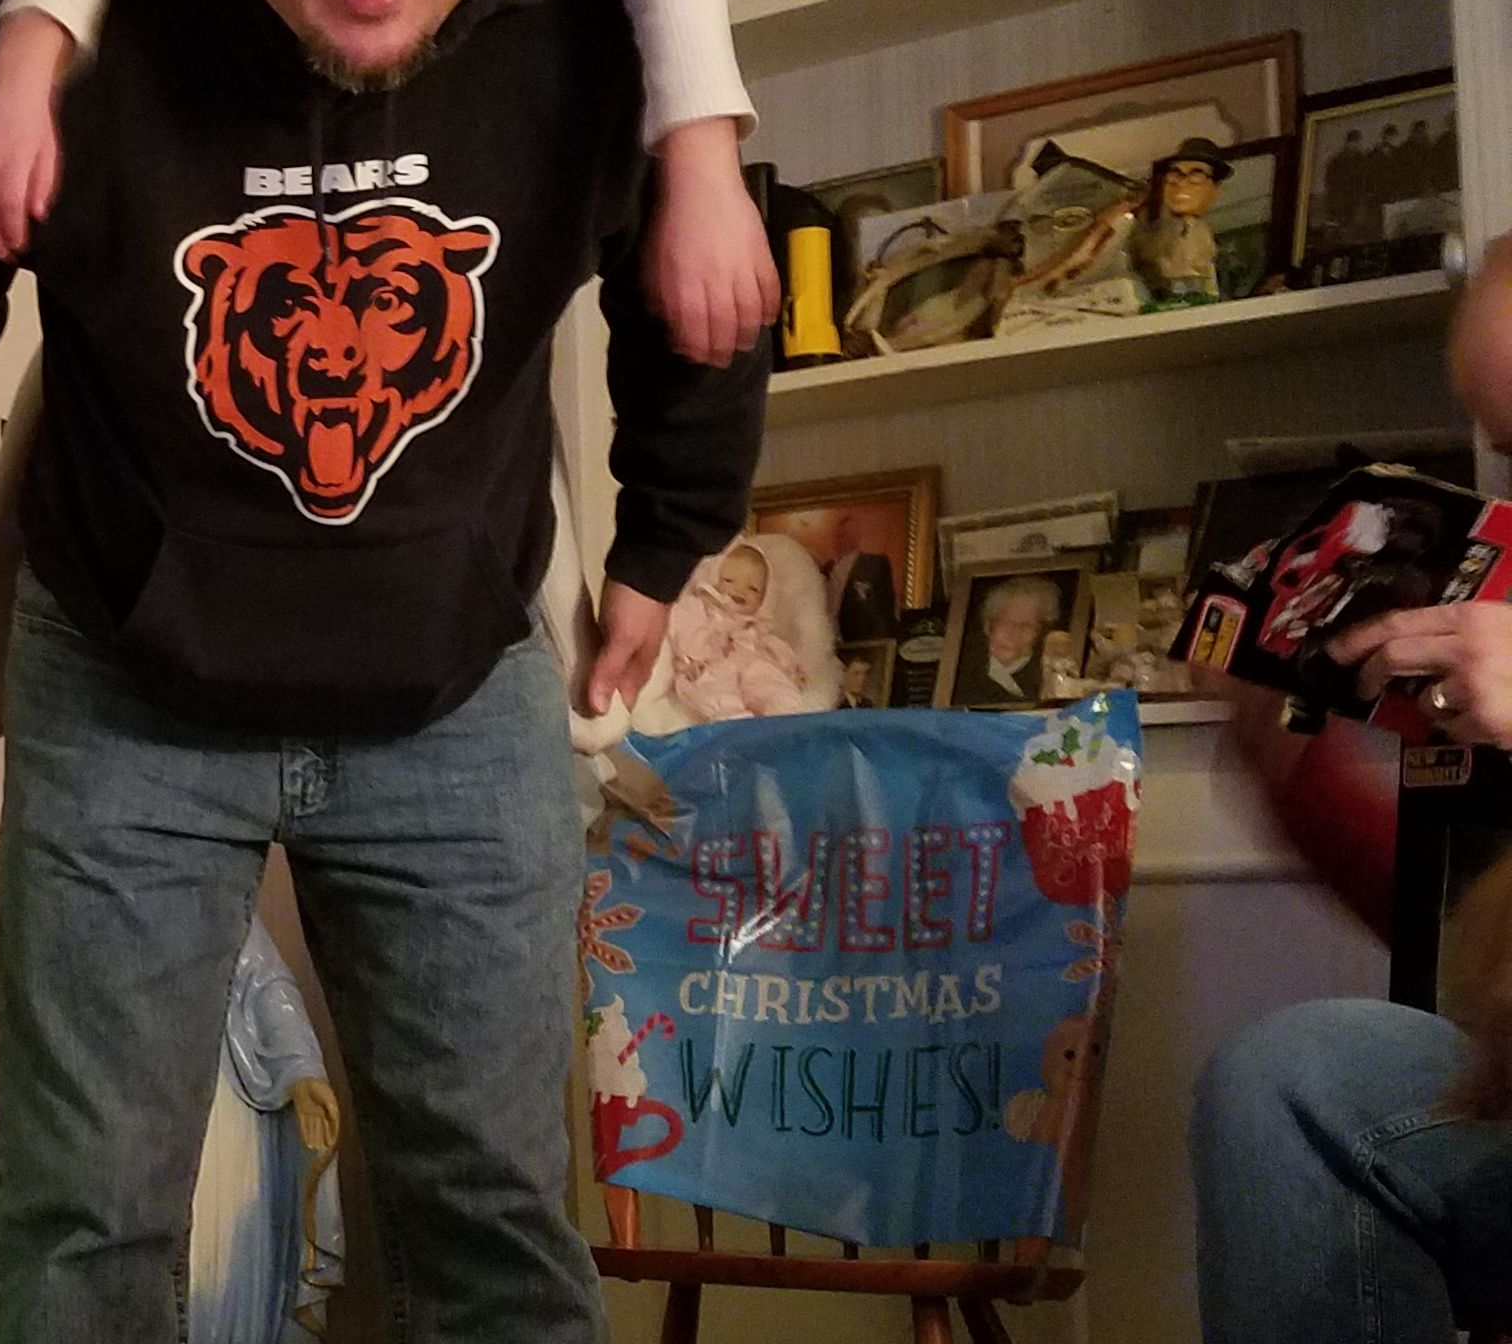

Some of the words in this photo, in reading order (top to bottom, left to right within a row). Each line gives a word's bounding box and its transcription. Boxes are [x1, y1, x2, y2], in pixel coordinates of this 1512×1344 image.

[243, 153, 430, 197] BEARS
[687, 825, 1009, 954] SWEET
[678, 963, 1003, 1025] CHRISTMAS
[679, 1038, 1002, 1143] WISHES!
